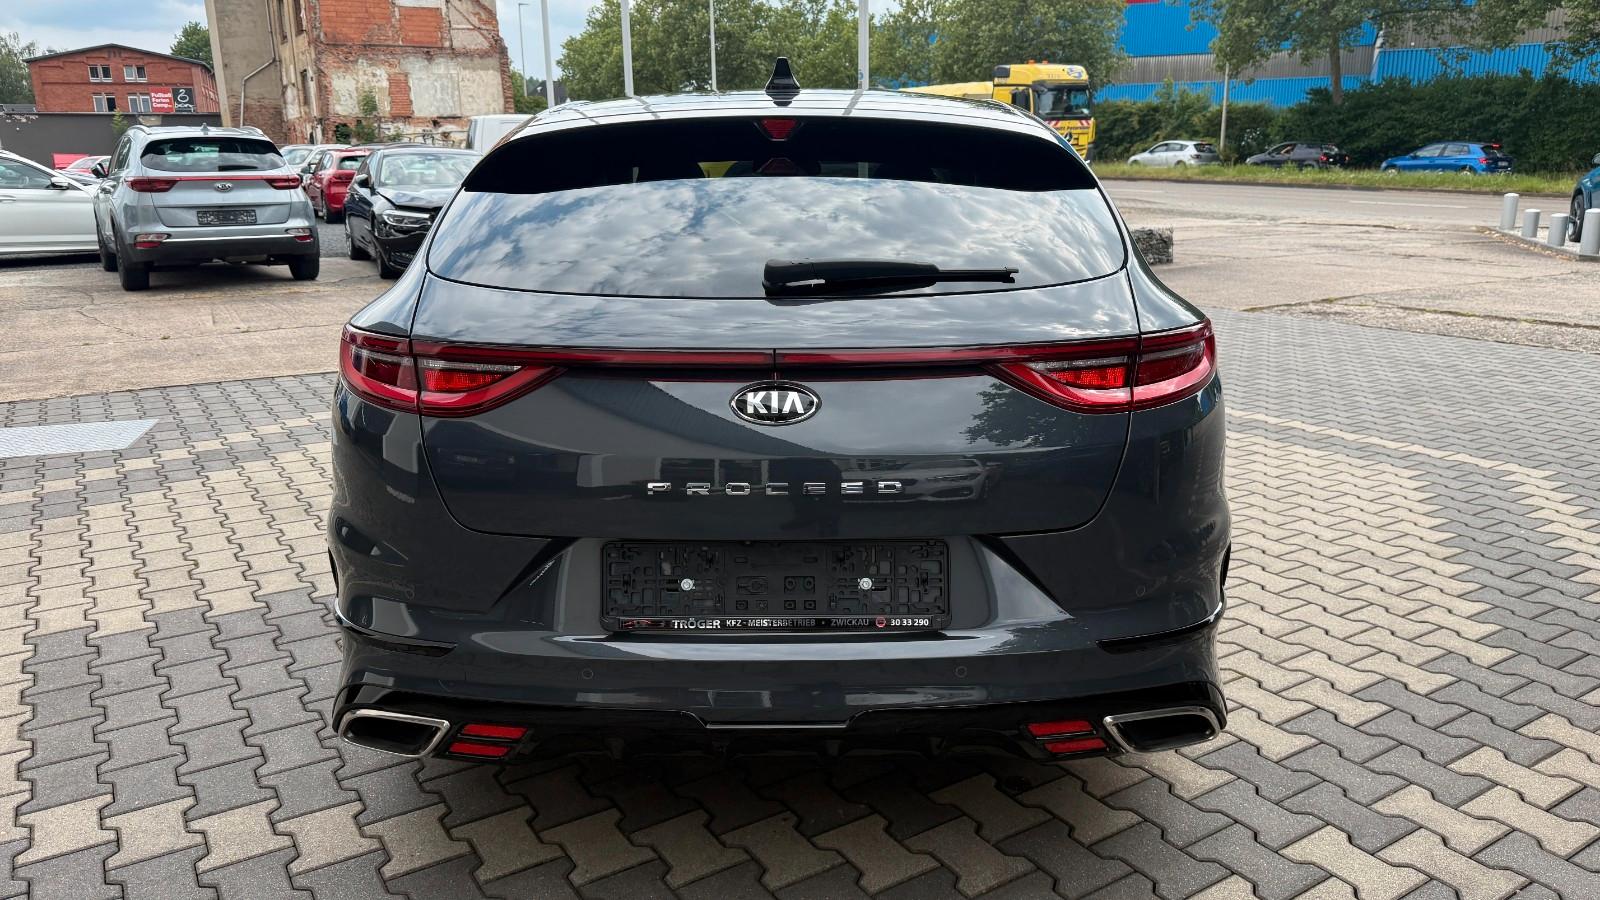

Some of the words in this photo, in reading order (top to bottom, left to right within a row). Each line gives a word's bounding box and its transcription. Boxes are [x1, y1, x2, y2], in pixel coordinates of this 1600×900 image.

[746, 391, 805, 414] KIA
[647, 482, 902, 496] PROCEED
[672, 617, 721, 629] TRÖGER
[830, 618, 869, 626] ZWICKAU
[890, 618, 900, 626] 30
[902, 618, 912, 626] 33
[914, 618, 929, 626] 290
